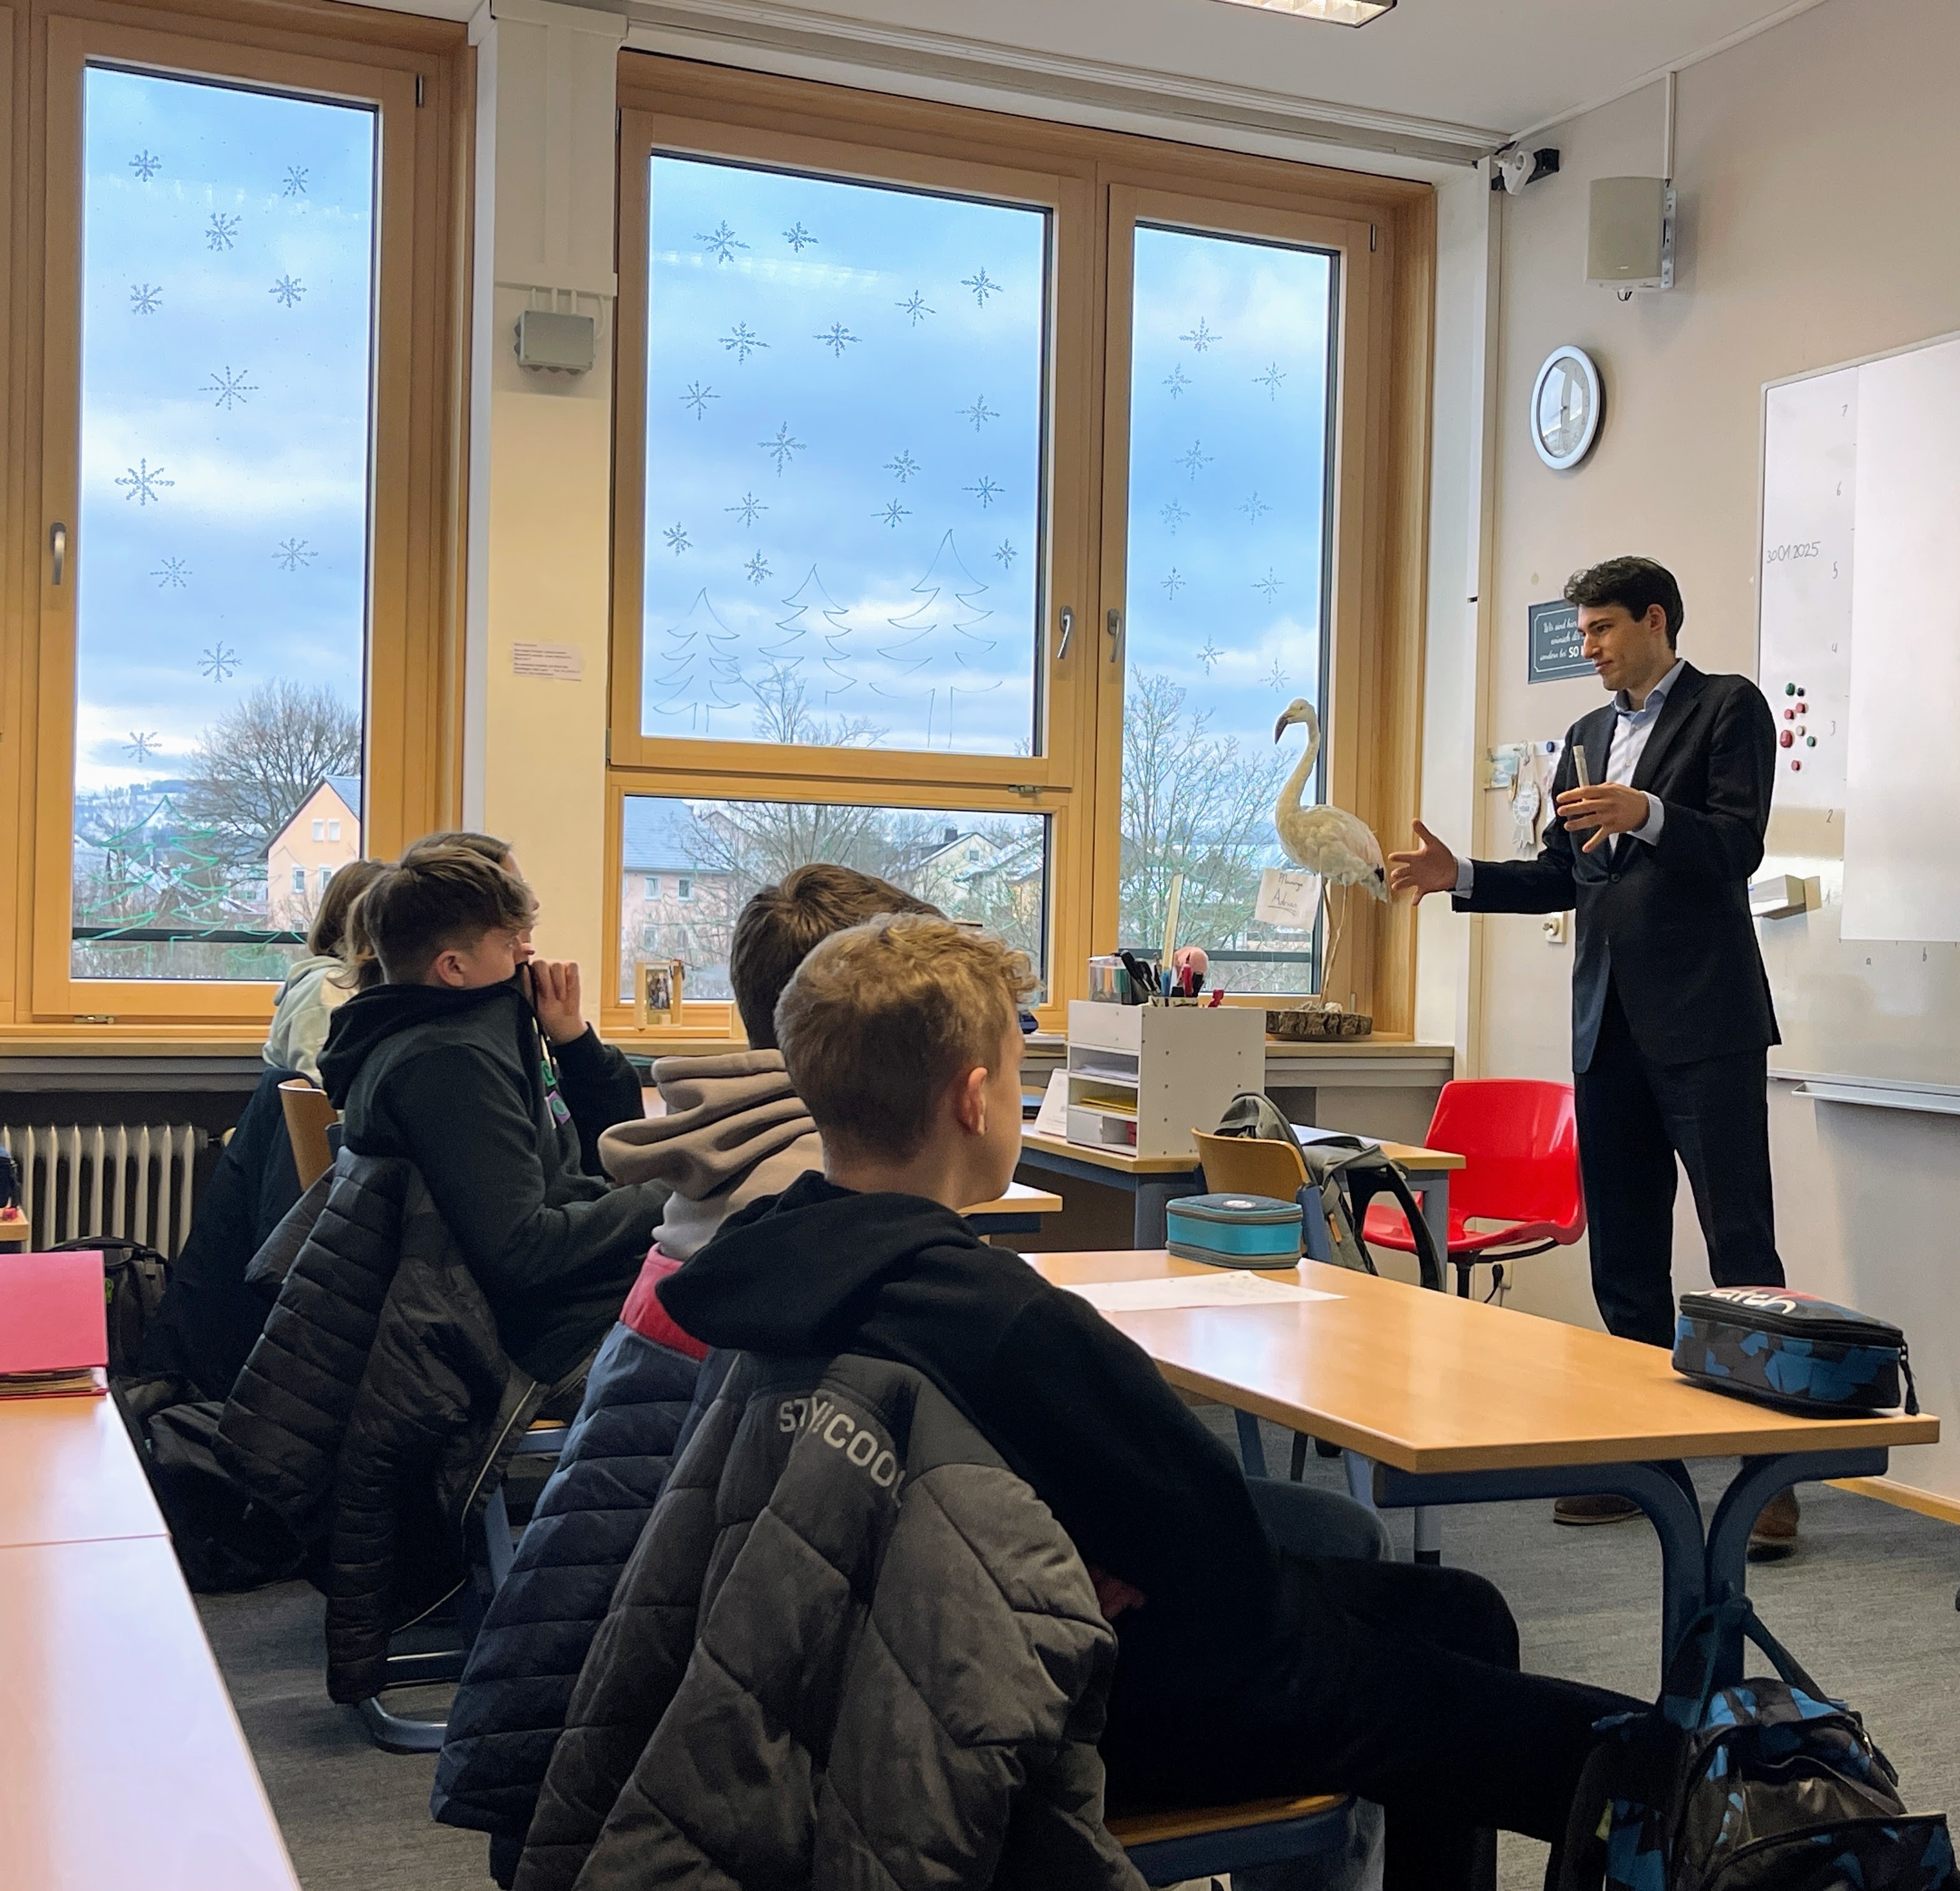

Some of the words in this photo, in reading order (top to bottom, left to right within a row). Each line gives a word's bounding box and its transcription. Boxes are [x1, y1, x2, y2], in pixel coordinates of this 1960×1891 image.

[1836, 481, 1842, 497] 6
[1832, 561, 1839, 580] 5
[1569, 645, 1579, 658] SO
[1829, 720, 1836, 737] 3
[1826, 809, 1834, 824] 2
[1922, 946, 1927, 962] b
